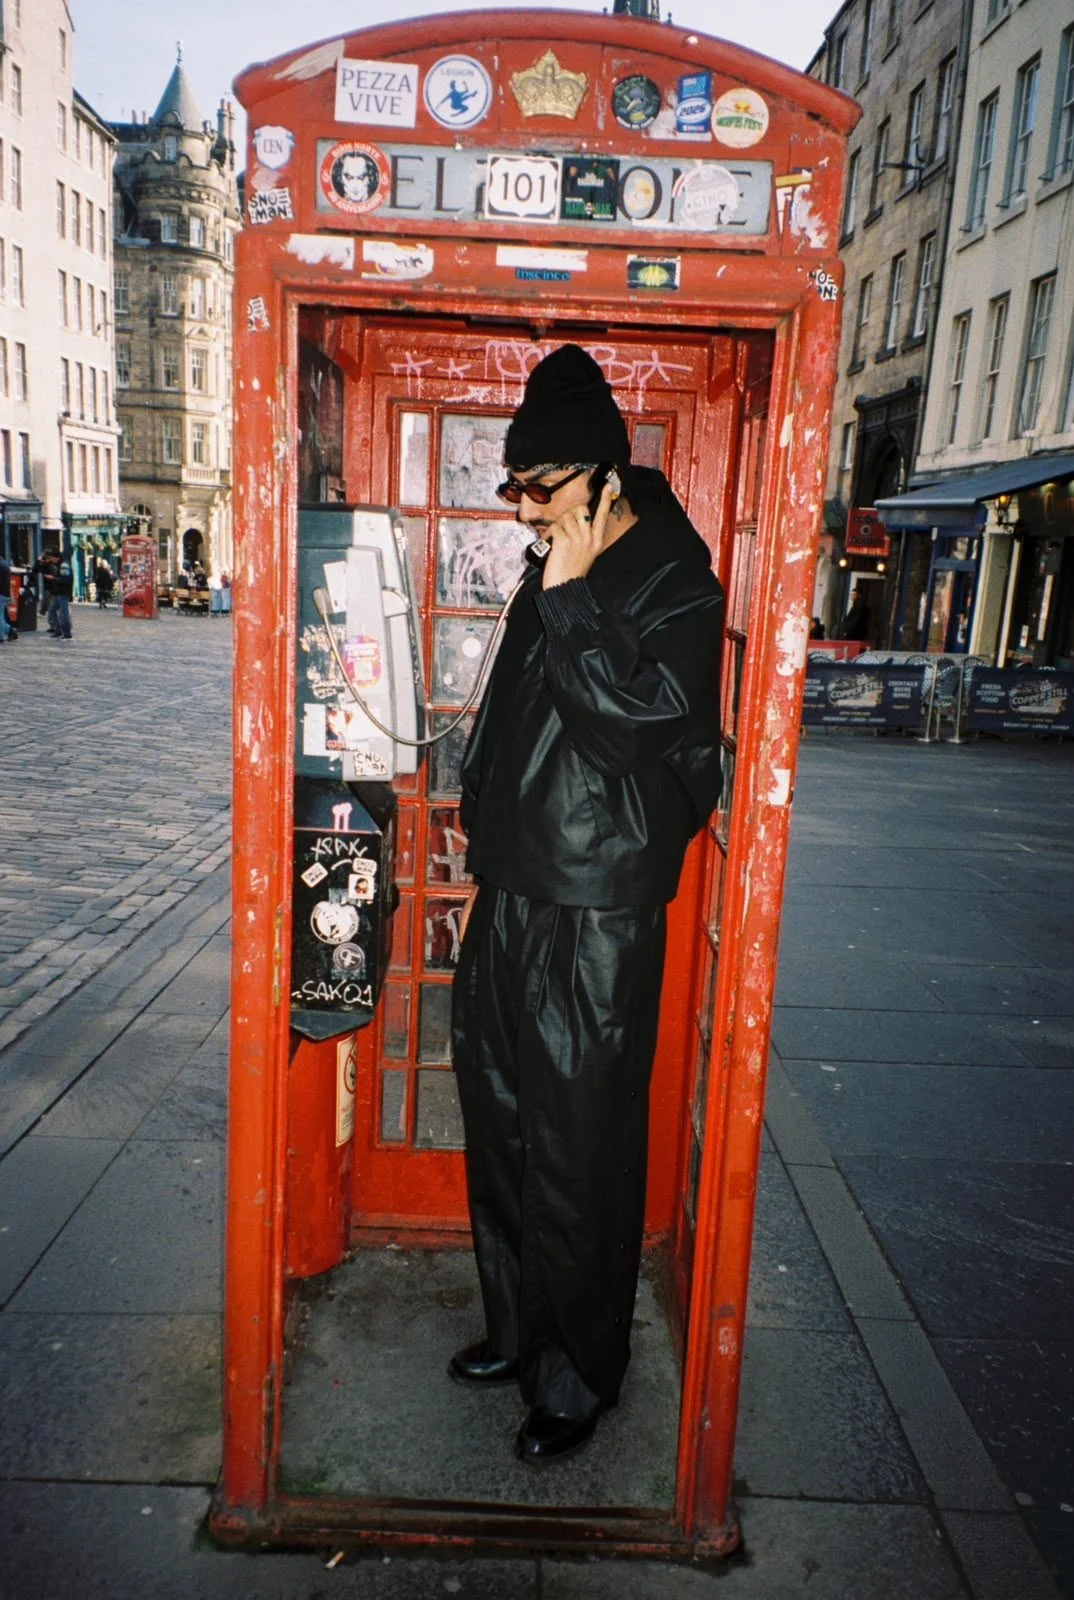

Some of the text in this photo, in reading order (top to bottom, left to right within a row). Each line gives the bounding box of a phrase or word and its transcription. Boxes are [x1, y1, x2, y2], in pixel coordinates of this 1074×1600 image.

[341, 68, 412, 93] PEZZA
[349, 92, 403, 115] VIVE
[502, 171, 545, 204] 101
